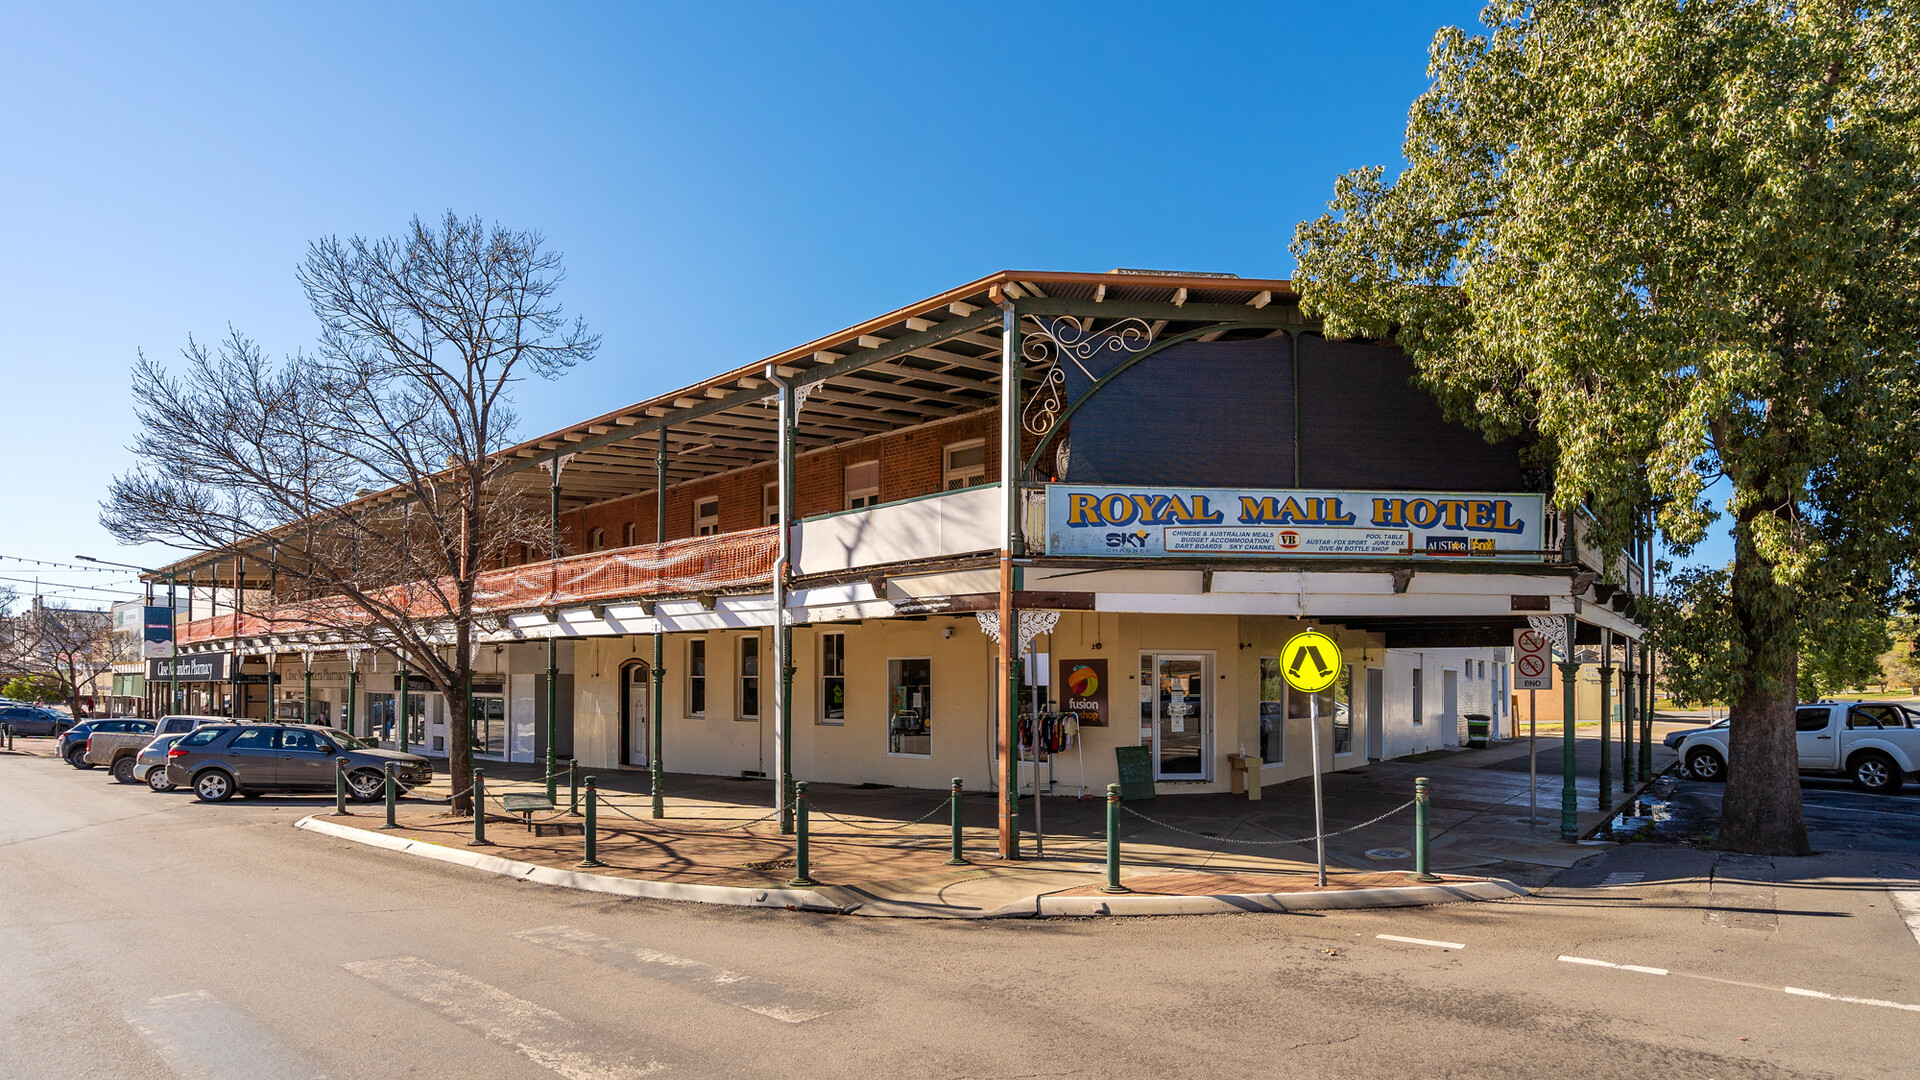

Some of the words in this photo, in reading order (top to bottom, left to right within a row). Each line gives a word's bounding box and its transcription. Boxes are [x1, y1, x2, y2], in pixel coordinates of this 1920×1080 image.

[1067, 493, 1224, 528] ROYAL
[1238, 495, 1356, 526] MAIL
[1371, 498, 1525, 534] HOTEL
[1105, 529, 1151, 548] SKY
[1280, 535, 1296, 545] VB
[191, 658, 213, 680] Pharmacy
[1069, 698, 1099, 710] fusion
